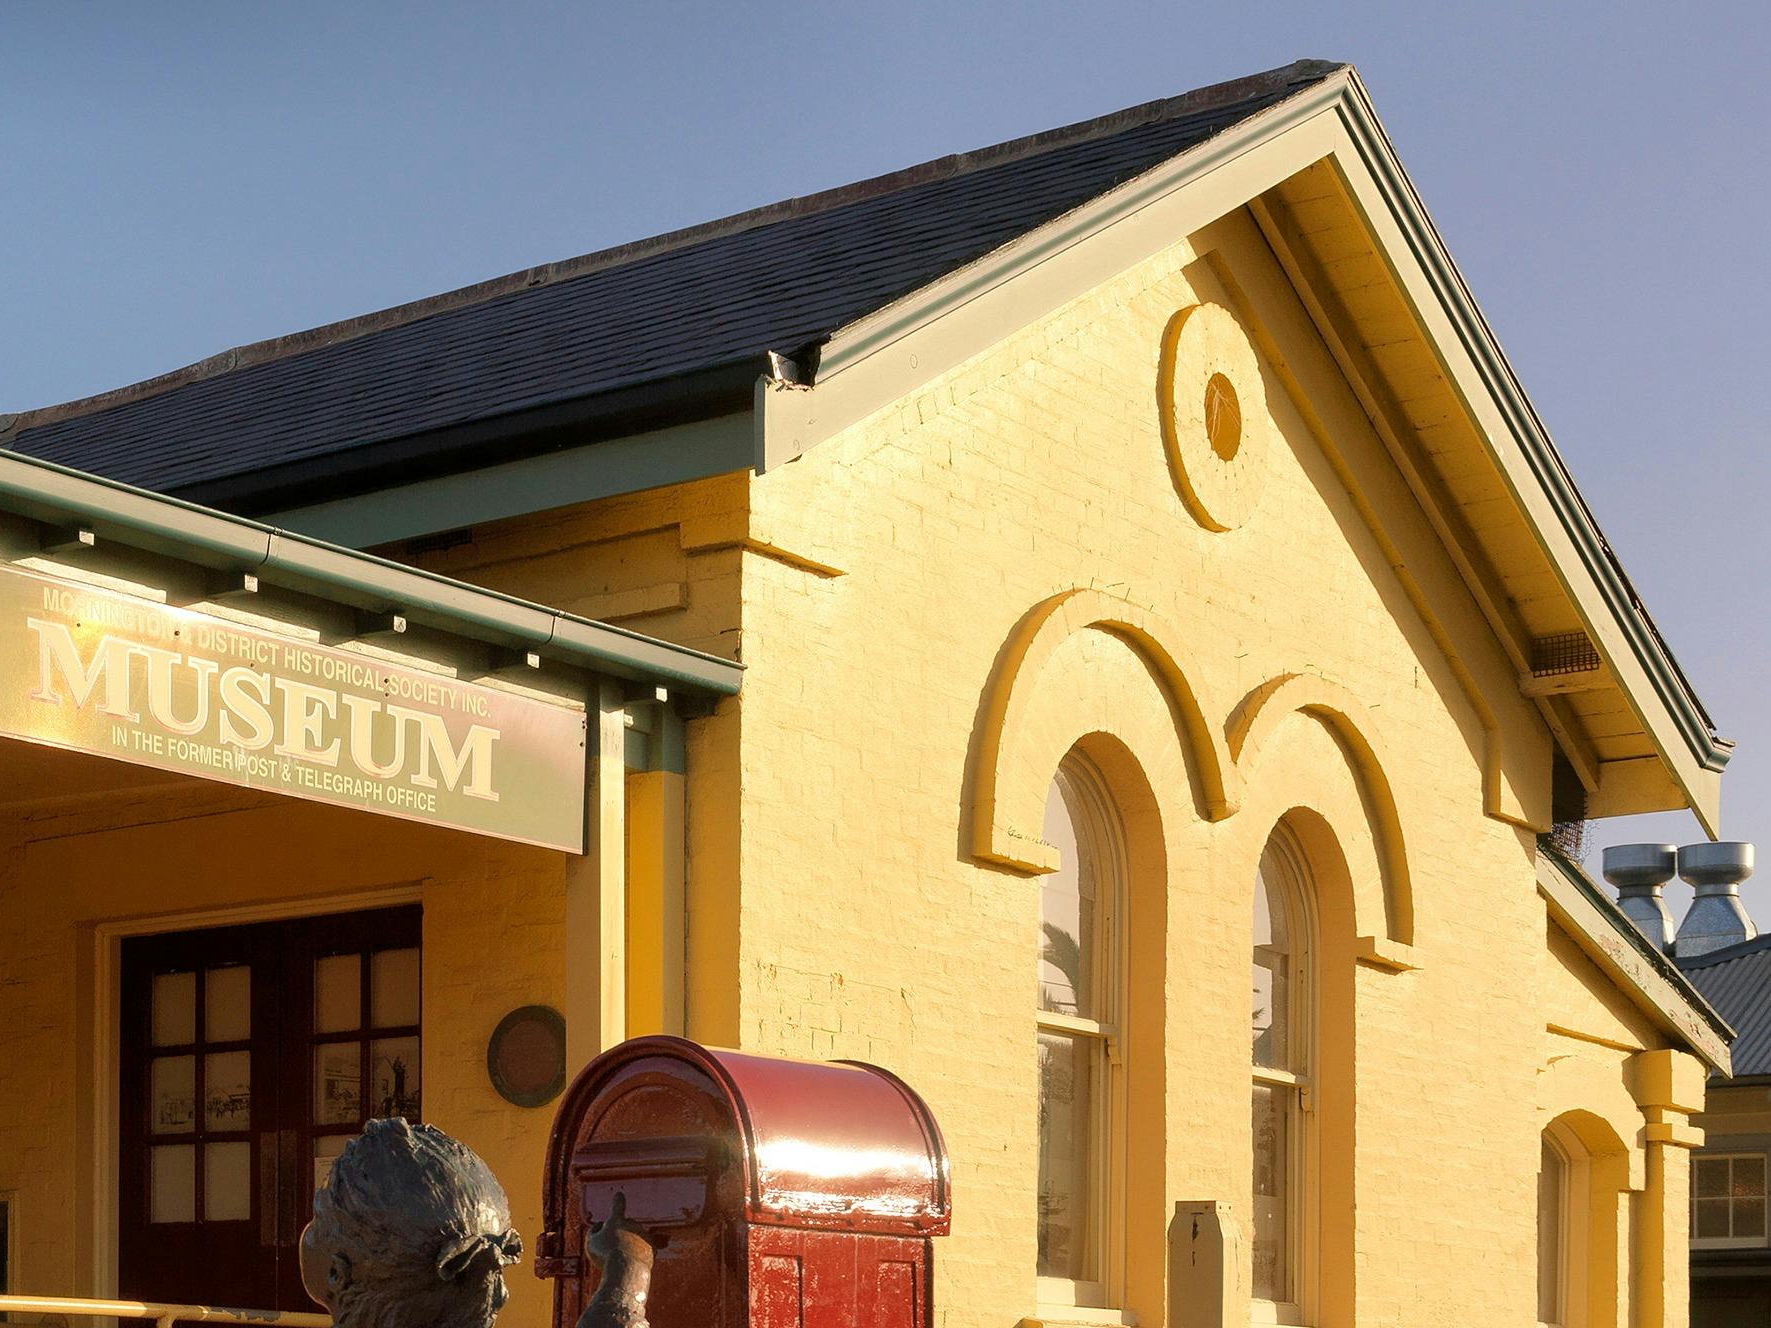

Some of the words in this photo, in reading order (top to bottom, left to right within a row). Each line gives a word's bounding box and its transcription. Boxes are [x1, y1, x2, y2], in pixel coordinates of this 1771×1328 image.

[28, 617, 500, 802] MUSEUM
[197, 624, 278, 666] DISTRICT
[284, 647, 384, 690] HISTORICAL
[389, 676, 458, 712] SOCIETY
[462, 693, 491, 718] INC.
[112, 726, 128, 747] IN
[132, 729, 163, 755] THE
[167, 737, 232, 770] FORMER
[236, 748, 277, 778] POST
[281, 762, 292, 781] &
[296, 764, 382, 802] TELEGRAPH
[386, 783, 436, 812] OFFICE
